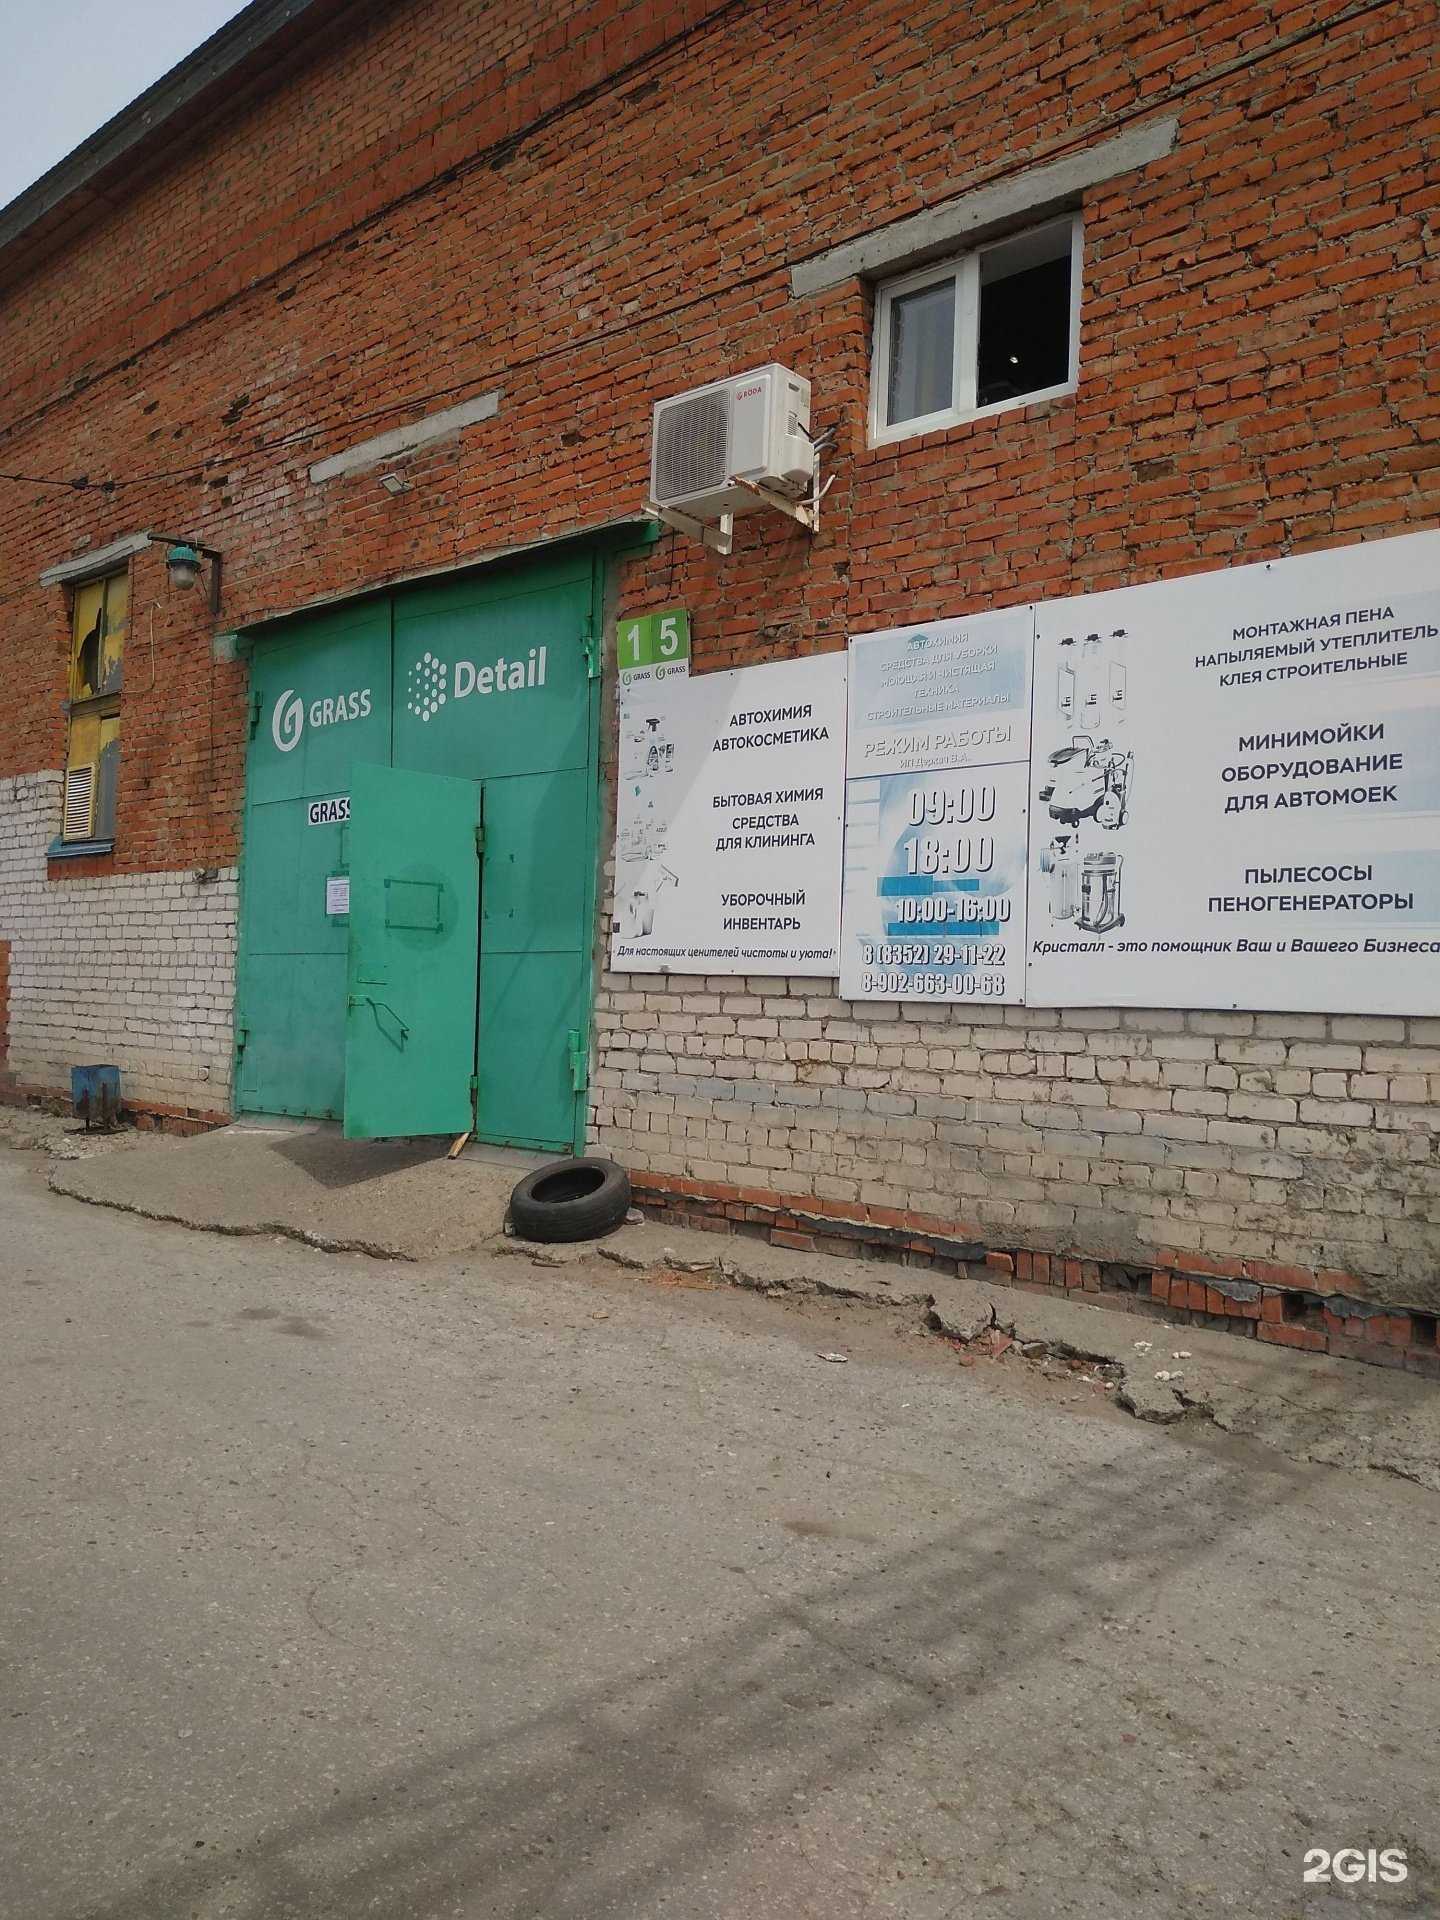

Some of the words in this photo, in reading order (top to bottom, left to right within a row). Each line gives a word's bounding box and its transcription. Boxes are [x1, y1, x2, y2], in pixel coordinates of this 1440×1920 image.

[1232, 614, 1341, 641] МОНТАЖНАЯ
[1345, 606, 1394, 625] ПЕНА
[1195, 638, 1315, 668] НАПЫЛЯЕМЫЙ
[1320, 624, 1438, 651] УТЕПЛИТЕЛЬ
[454, 646, 547, 698] Detail
[633, 672, 651, 681] GRASS
[667, 666, 686, 675] GRASS
[1219, 670, 1262, 687] КЛЕЯ
[1266, 652, 1408, 681] СТРОИТЕЛЬНЫЕ
[309, 688, 372, 728] GRASS
[729, 704, 812, 727] АВТОХИМИЯ
[712, 727, 829, 752] АВТОКОСМЕТИКА
[864, 733, 930, 758] РЕЖИМ
[934, 725, 1012, 750] РАБОТЫ
[1239, 722, 1384, 752] МИНИМОЙКИ
[1221, 753, 1403, 782] ОБОРУДОВАНИЕ
[712, 790, 773, 808] БЫТОВАЯ
[775, 787, 824, 804] ХИМИЯ
[909, 786, 996, 827] 09:00
[1224, 794, 1268, 814] ДЛЯ
[1274, 785, 1398, 809] АВТОМОЕК
[732, 813, 799, 830] СРЕДСТВА
[715, 837, 742, 851] ДЛЯ
[744, 834, 815, 849] КЛИНИНГА
[904, 836, 994, 875] 18:00
[1245, 865, 1373, 884] ПЫЛЕСОСЫ
[721, 889, 806, 906] УБОРОЧНЫЙ
[896, 895, 1011, 923] 10:00-16:00
[1208, 893, 1414, 913] ПЕНОГЕНЕРАТОРЫ
[723, 917, 801, 930] ИНВЕНТАРЬ
[617, 946, 634, 957] Для
[635, 947, 686, 958] настоящих
[687, 946, 740, 959] ценителей
[741, 949, 789, 959] чистоты
[790, 949, 797, 959] и
[798, 948, 833, 961] уюта!
[863, 944, 874, 965] 8
[877, 944, 930, 966] (8352)
[933, 944, 1005, 966] 29-11-22
[1033, 940, 1105, 956] Кристалл
[1117, 941, 1148, 952] это
[1151, 940, 1232, 955] помощник
[1236, 939, 1272, 953] Ваш
[1276, 941, 1286, 952] и
[1291, 939, 1358, 953] Вашего
[1363, 938, 1440, 953] Бизнеса
[862, 972, 1005, 995] 8-902-663-00-68
